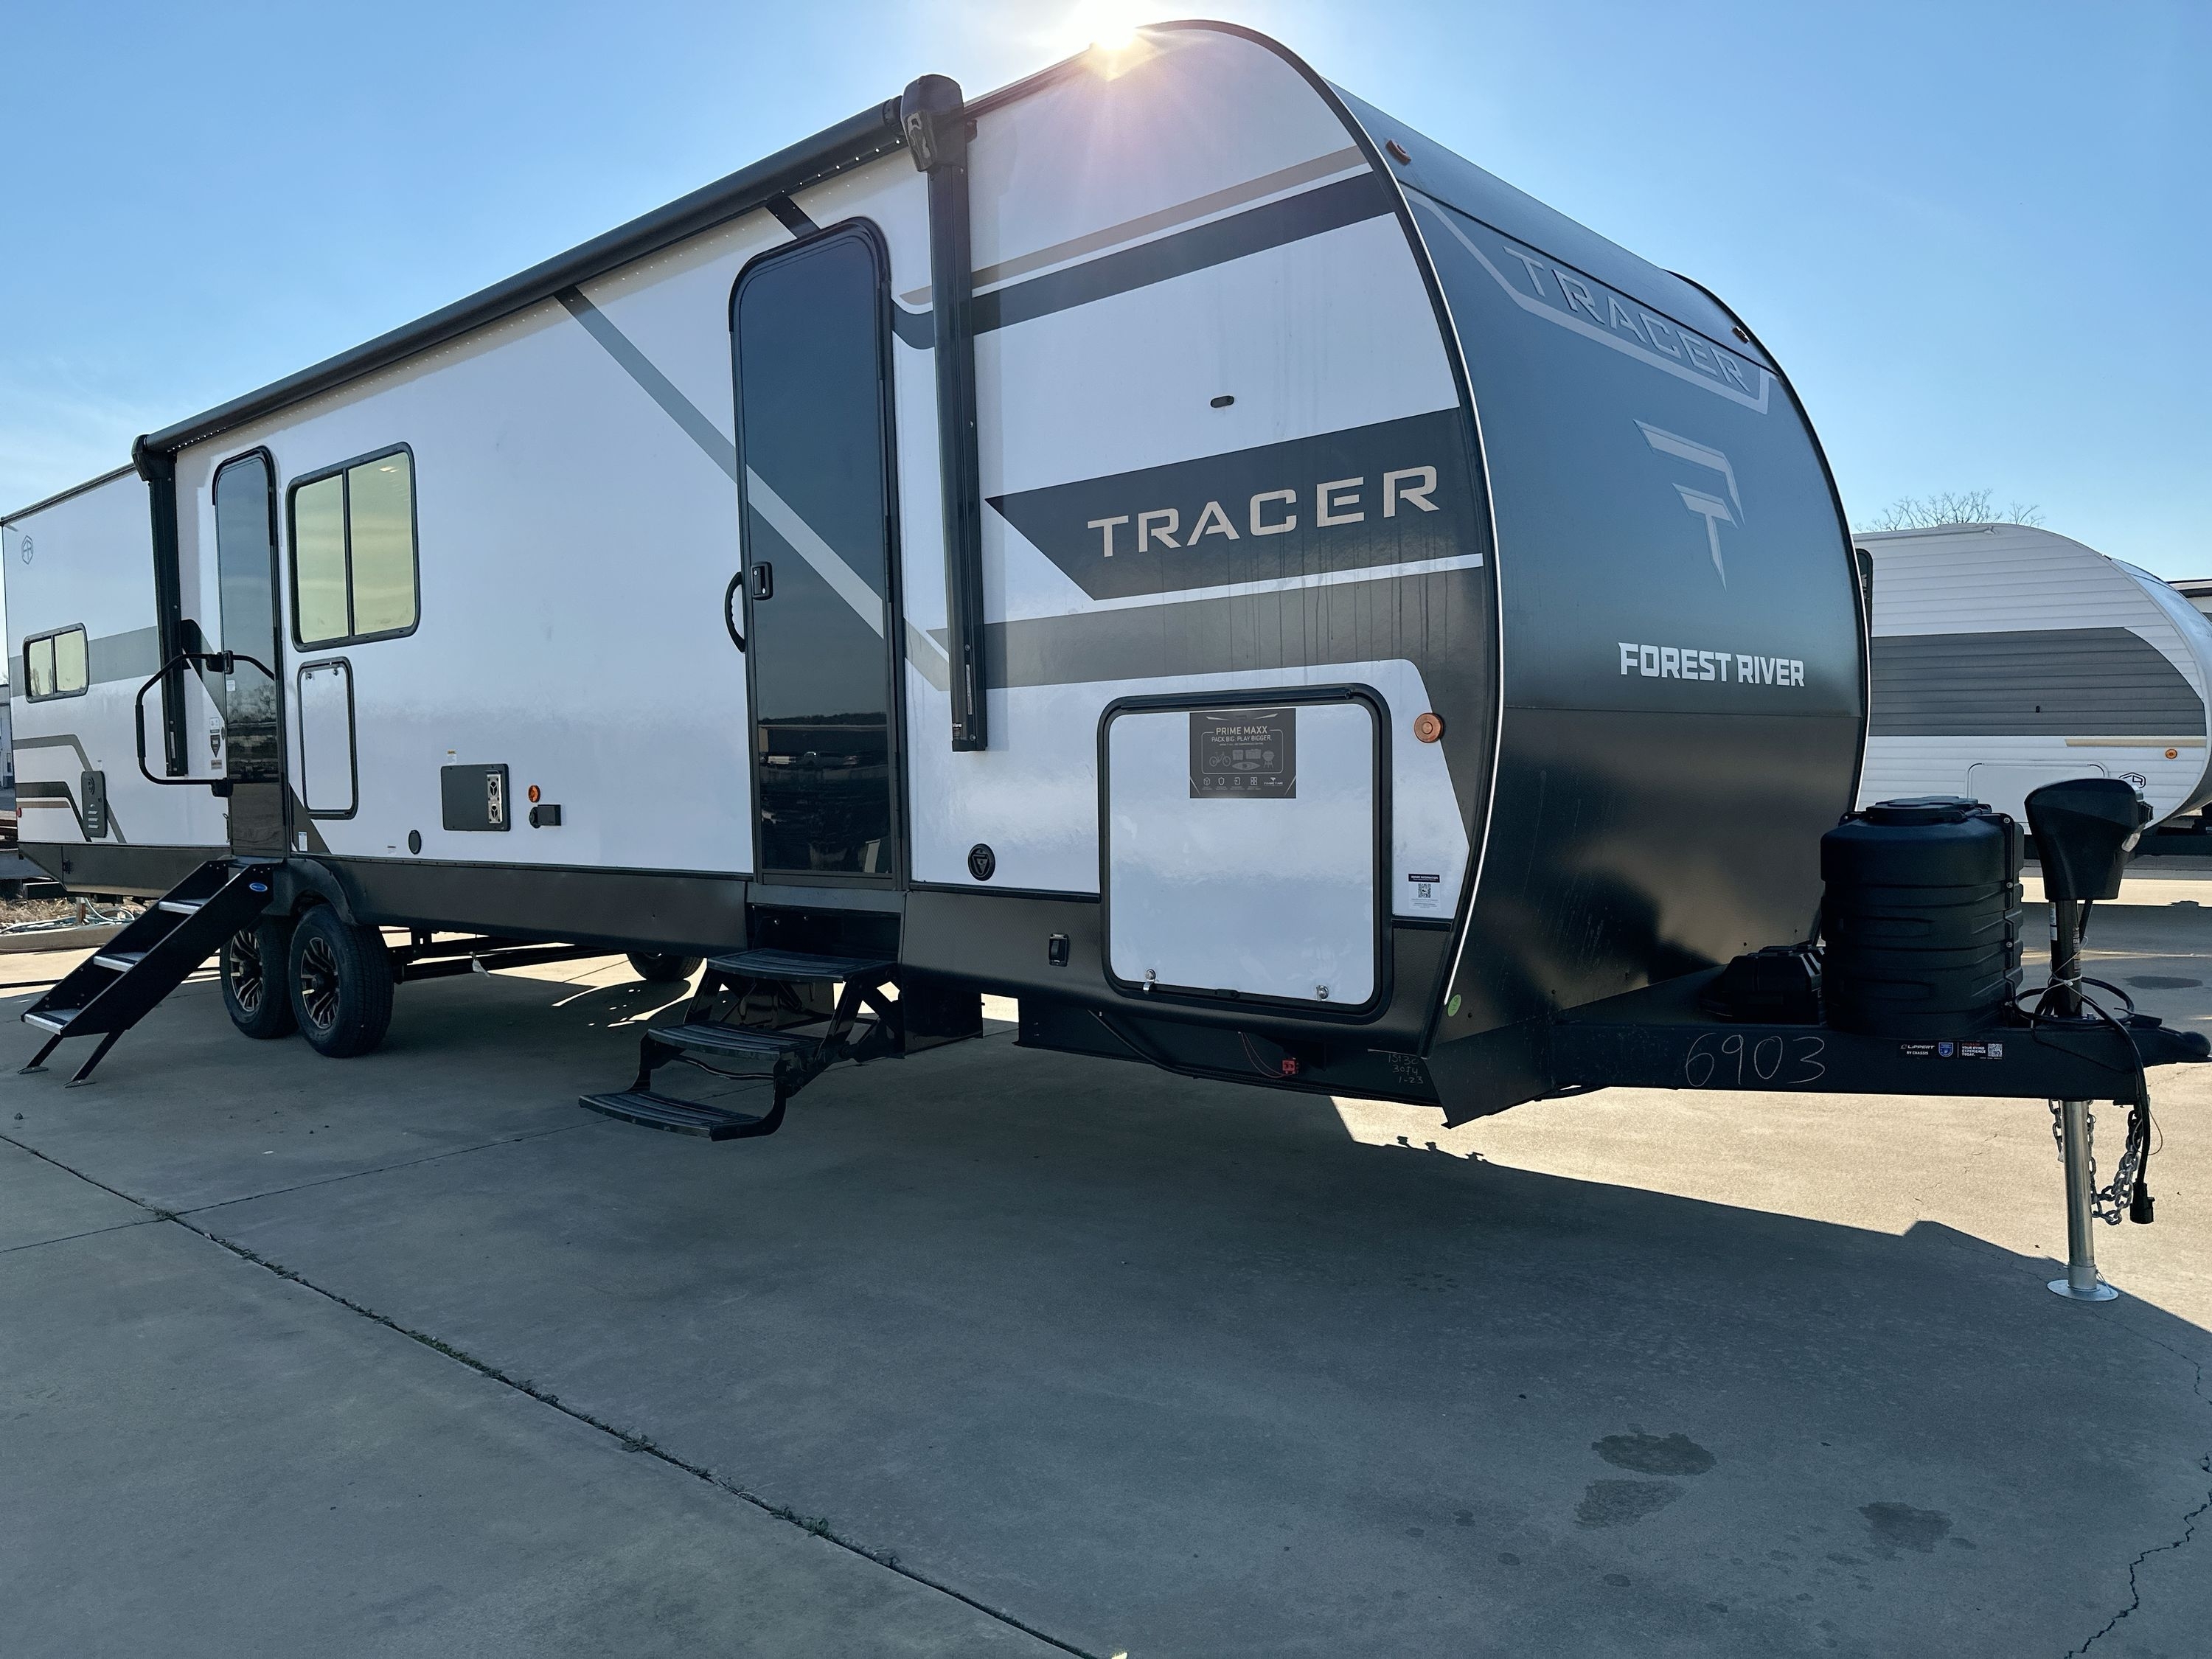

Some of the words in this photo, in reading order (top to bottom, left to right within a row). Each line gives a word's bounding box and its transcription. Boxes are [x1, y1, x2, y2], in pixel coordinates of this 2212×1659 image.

[1502, 246, 1751, 393] TRACER
[1088, 465, 1440, 557] TRACER
[1618, 642, 1731, 682] FOREST
[1735, 654, 1805, 687] RIVER
[1216, 726, 1242, 735] PRIME
[1243, 726, 1267, 734] MAXX
[1684, 1032, 1826, 1087] 6903
